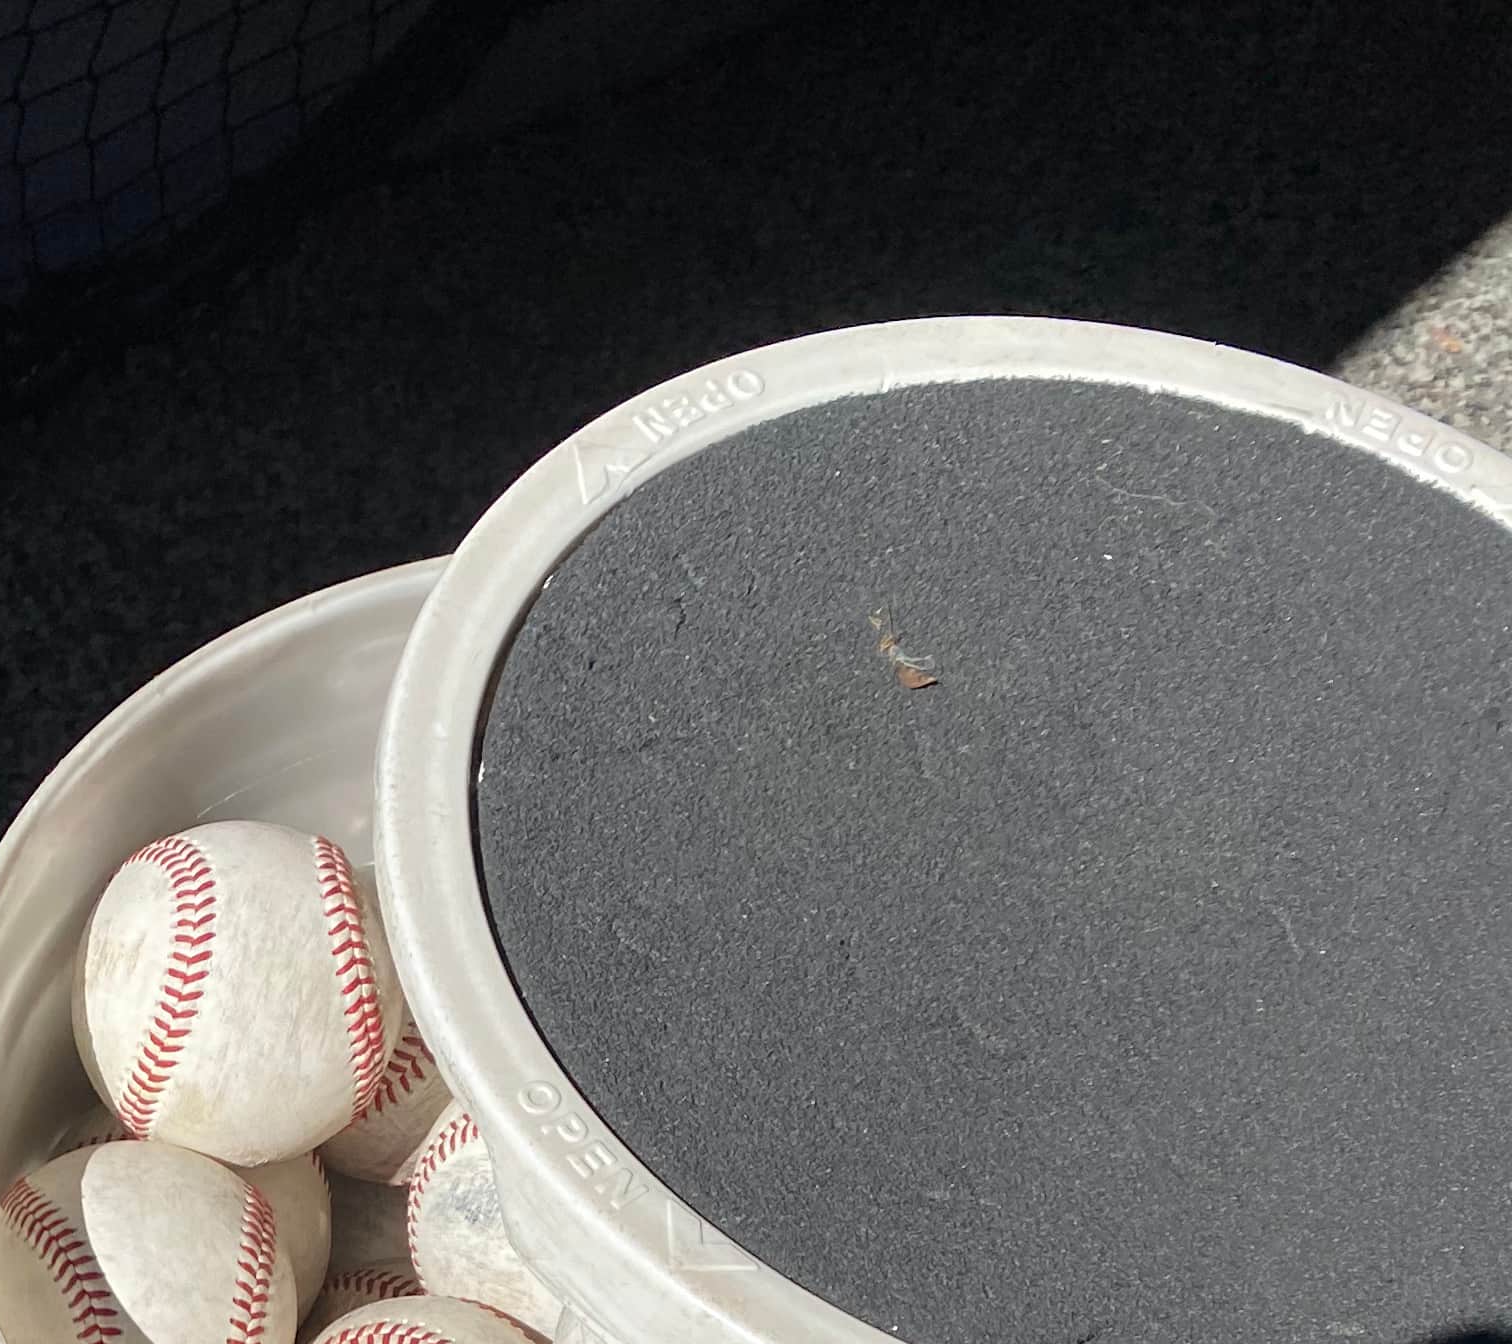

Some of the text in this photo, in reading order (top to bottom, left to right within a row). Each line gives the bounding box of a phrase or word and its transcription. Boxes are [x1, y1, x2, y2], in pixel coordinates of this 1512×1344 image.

[631, 368, 766, 444] OPEN
[1324, 391, 1474, 474] OPEN
[517, 1080, 650, 1211] OPEN
